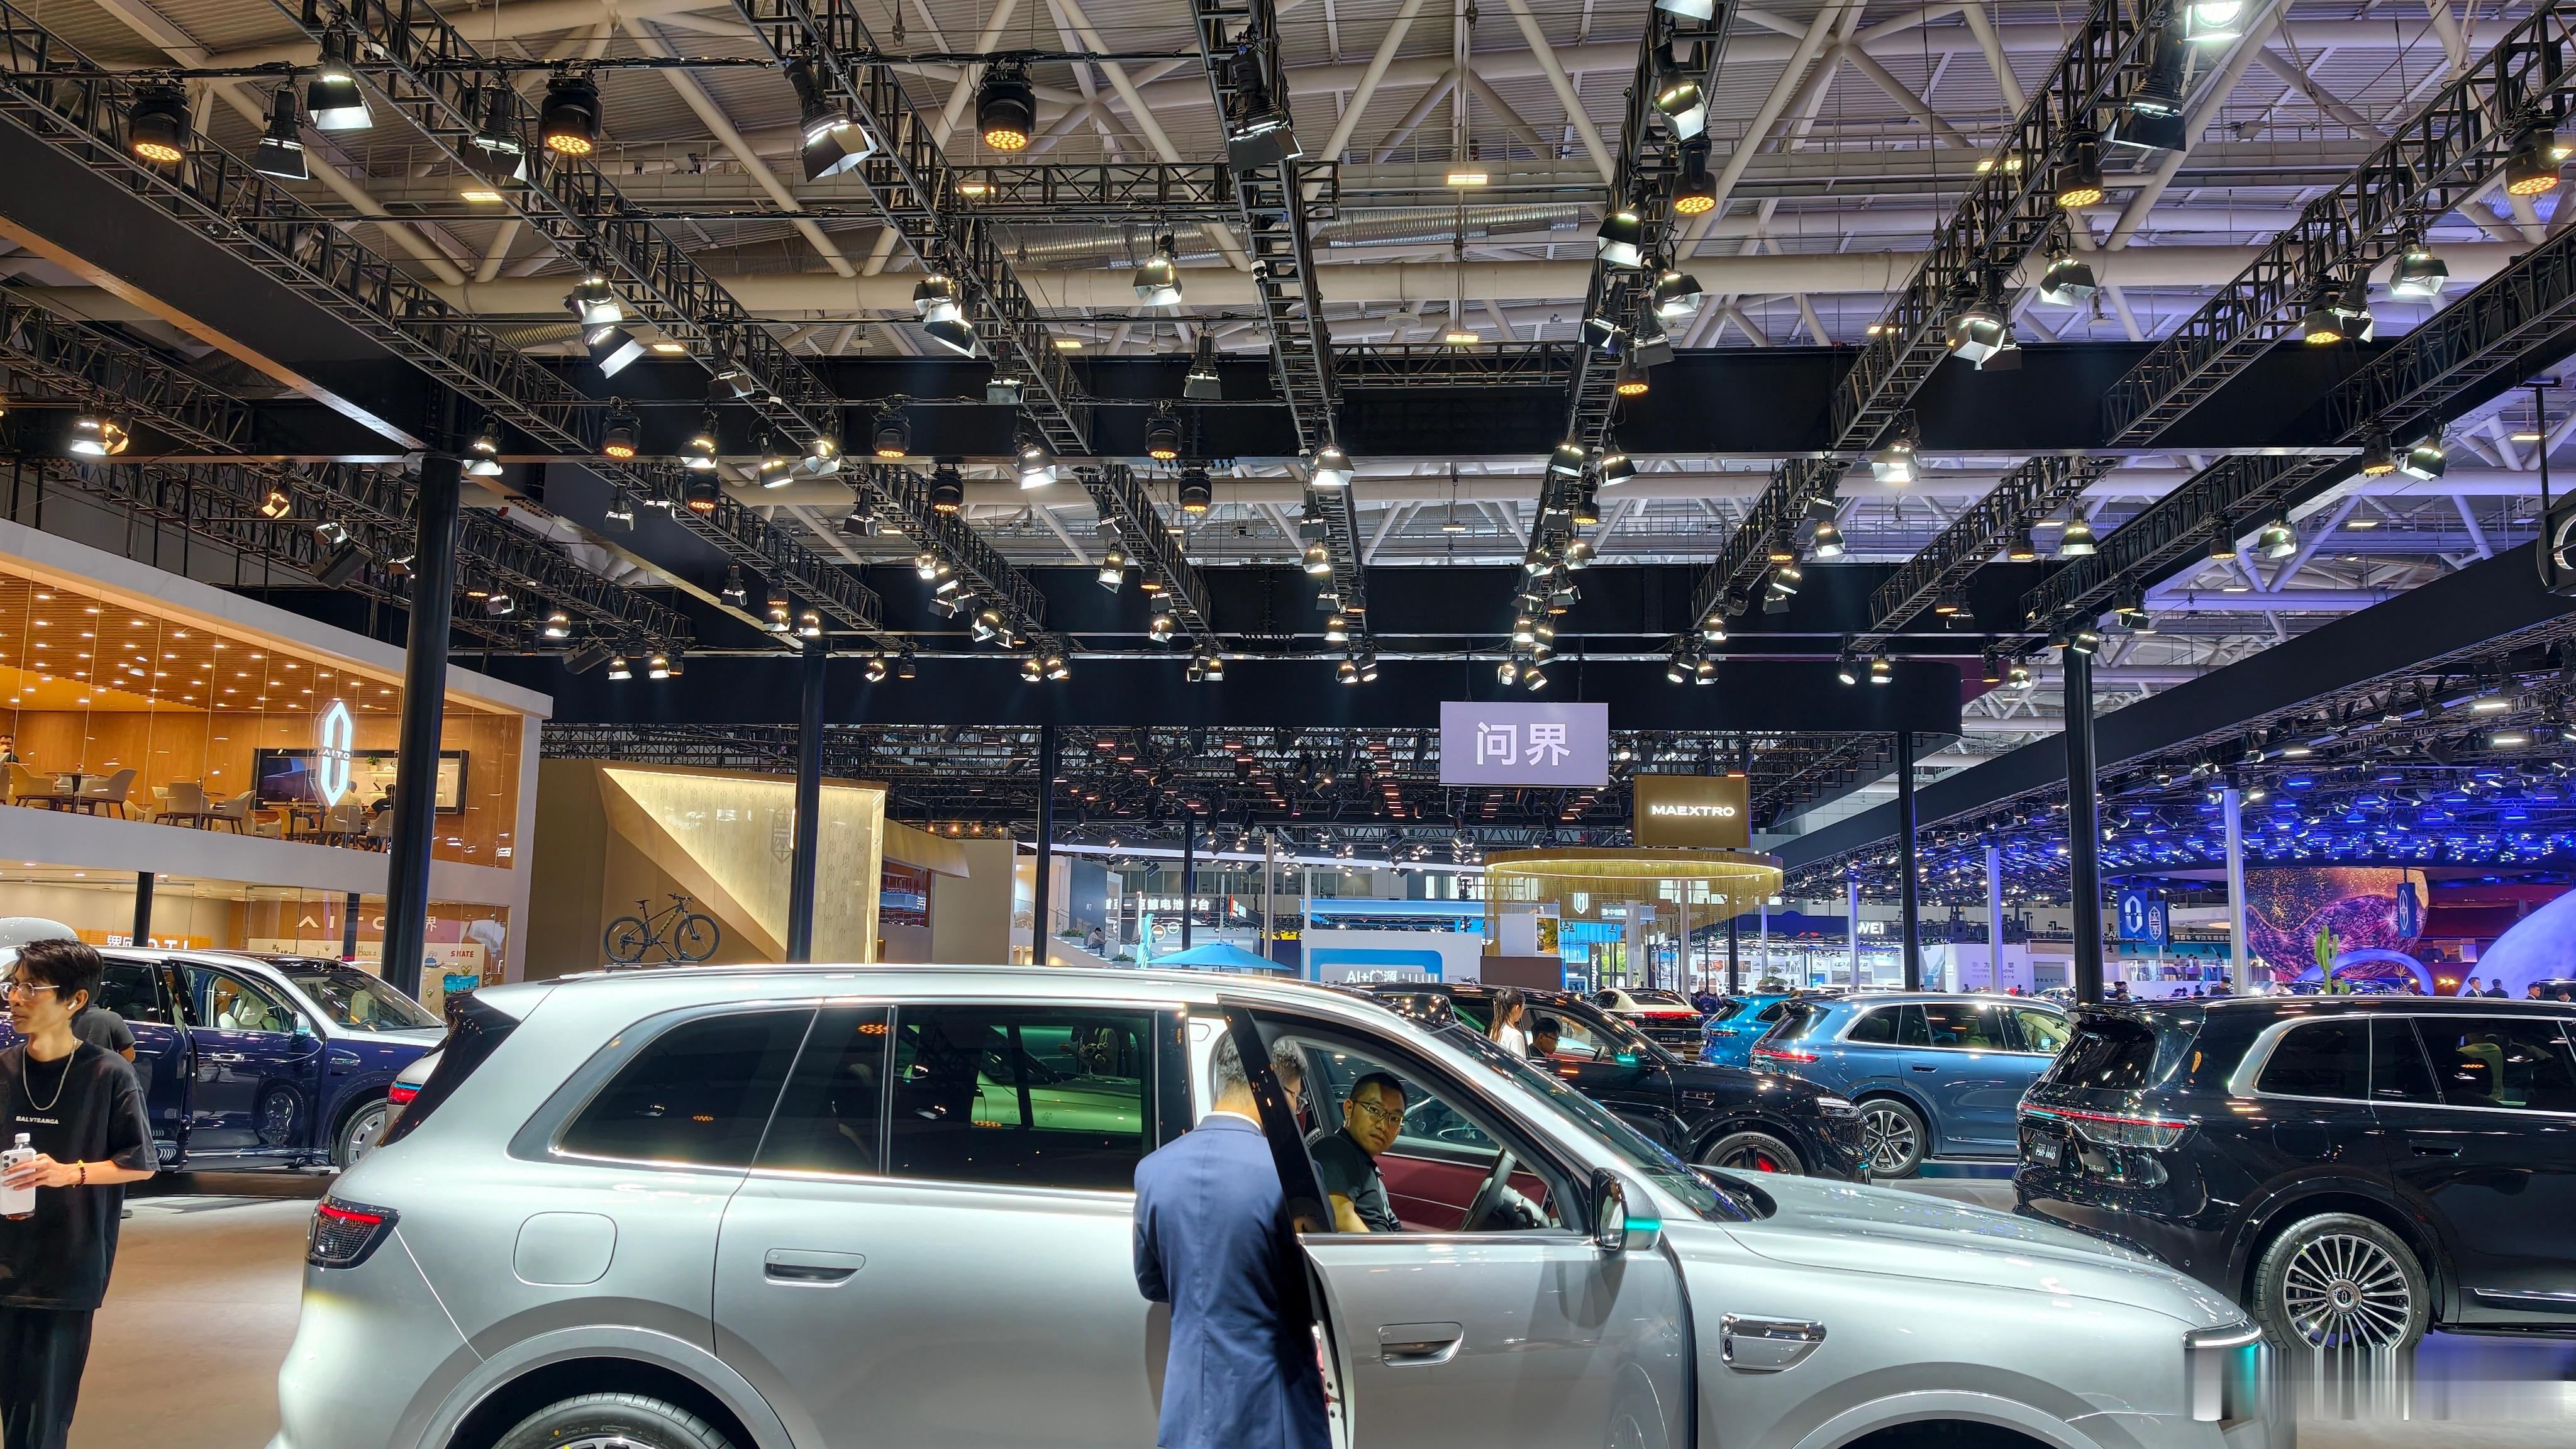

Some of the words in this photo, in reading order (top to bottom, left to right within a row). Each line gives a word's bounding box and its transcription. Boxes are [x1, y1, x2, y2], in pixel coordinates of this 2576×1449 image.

[1477, 721, 1570, 766] 问界
[323, 748, 350, 760] AITO
[1652, 805, 1736, 817] MAEXTRO
[297, 915, 386, 931] AIO
